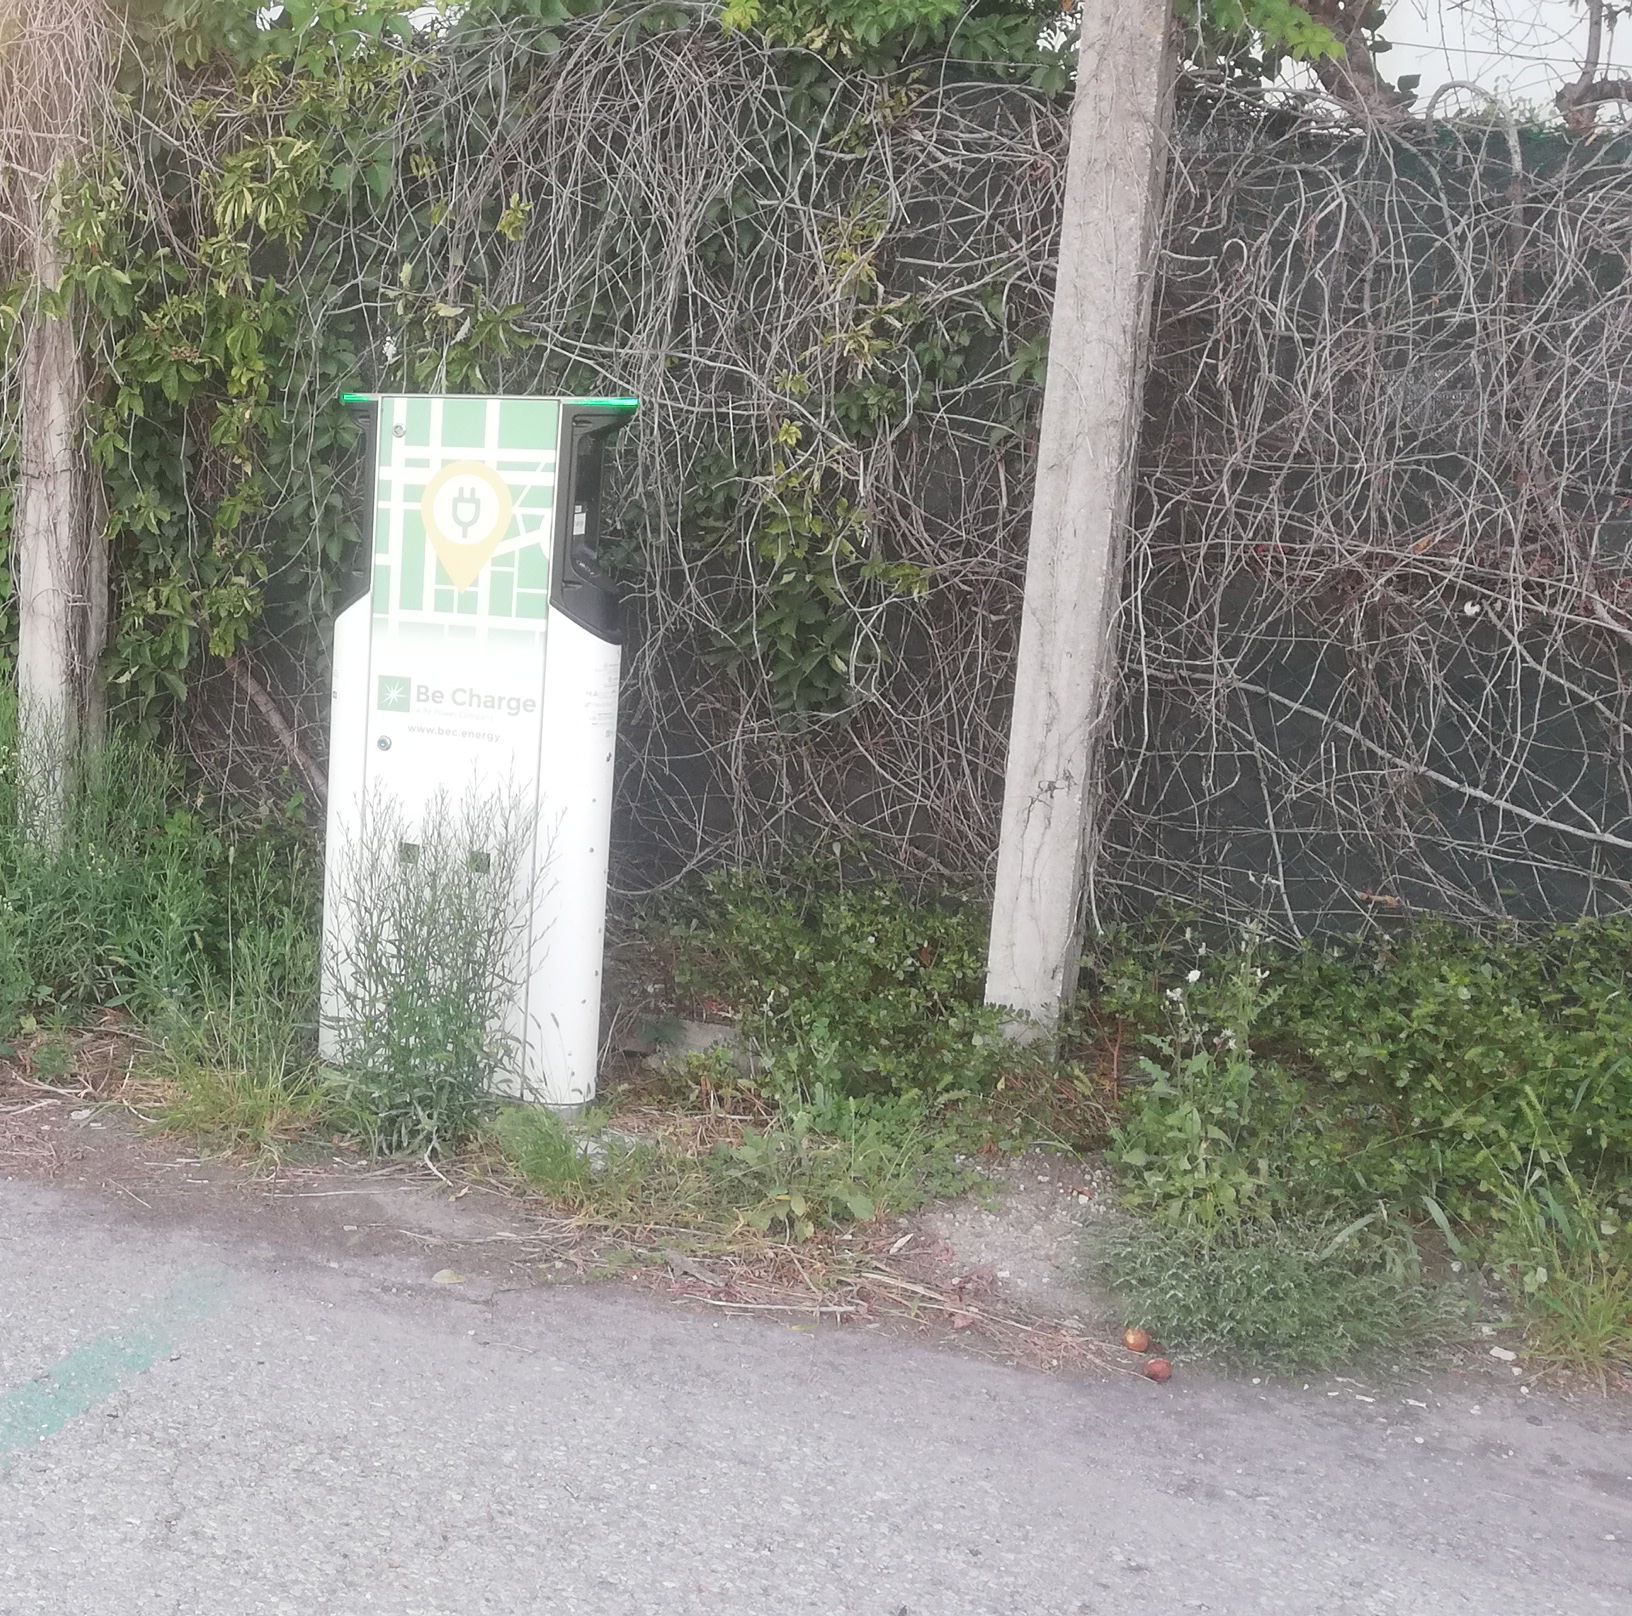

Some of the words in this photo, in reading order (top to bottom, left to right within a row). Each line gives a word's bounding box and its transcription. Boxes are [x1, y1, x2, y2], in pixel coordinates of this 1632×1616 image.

[415, 684, 445, 704] Be
[451, 687, 537, 717] Charge
[407, 725, 501, 743] www.bec.energy
